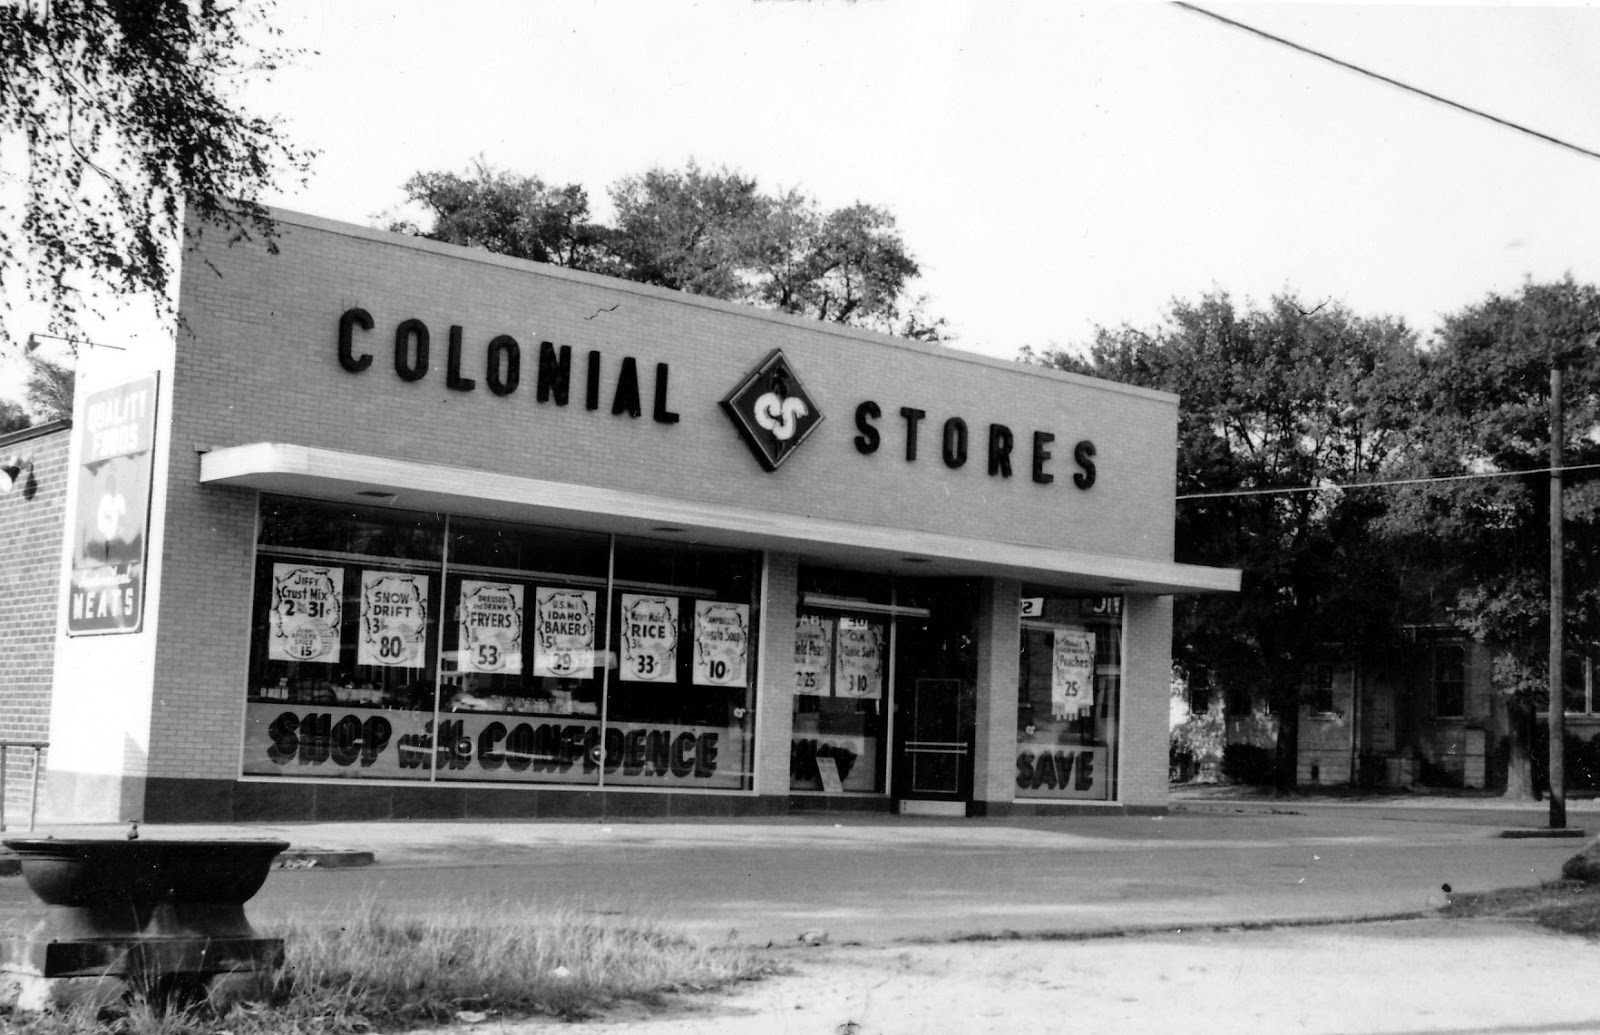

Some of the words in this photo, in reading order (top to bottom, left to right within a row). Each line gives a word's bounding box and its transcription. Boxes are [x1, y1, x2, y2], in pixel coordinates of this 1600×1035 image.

[338, 307, 680, 424] COLONIAL
[854, 400, 1098, 490] STORES
[88, 389, 147, 432] QUALITY
[92, 423, 139, 459] FOODS
[294, 574, 320, 586] JIFFY
[282, 586, 307, 600] Crust
[310, 588, 328, 600] Mix
[374, 591, 410, 604] SNOW
[477, 595, 508, 604] DRESSED
[73, 587, 134, 620] MEATS
[284, 600, 296, 616] 2
[373, 605, 412, 618] DRIFT
[548, 610, 582, 621] IDAHO
[372, 617, 380, 634] 3
[470, 612, 512, 629] FRYERS
[544, 621, 587, 636] BAKERS
[631, 624, 666, 639] RICE
[545, 635, 553, 649] 5
[267, 711, 392, 767] SHOP
[478, 721, 719, 778] CONFIDENCE
[1016, 750, 1094, 791] SAVE
